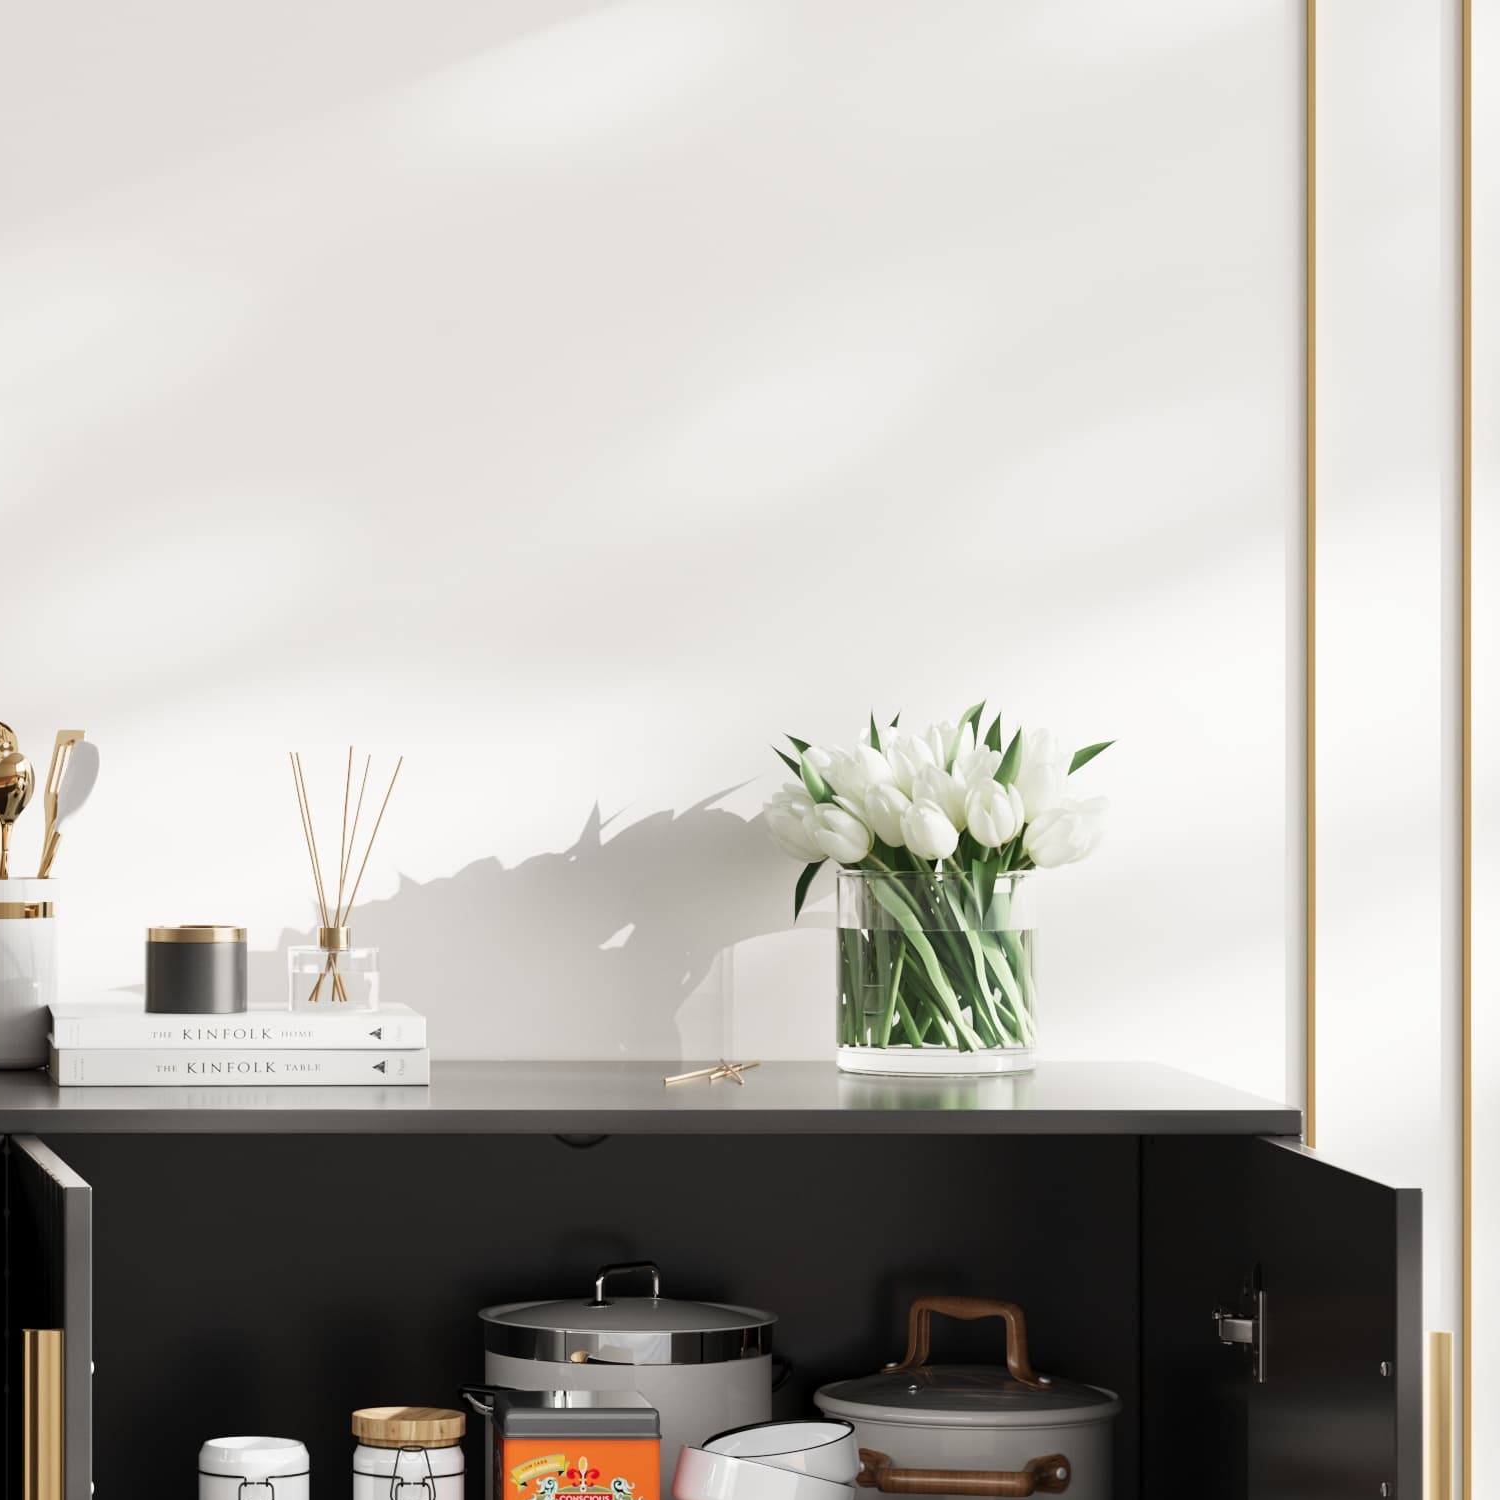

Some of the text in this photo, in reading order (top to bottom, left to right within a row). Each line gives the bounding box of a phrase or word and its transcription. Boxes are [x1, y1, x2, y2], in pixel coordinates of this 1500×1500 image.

[151, 1028, 315, 1040] THE KINFOLK HOME
[155, 1062, 322, 1074] THE KINFOLK TABLE
